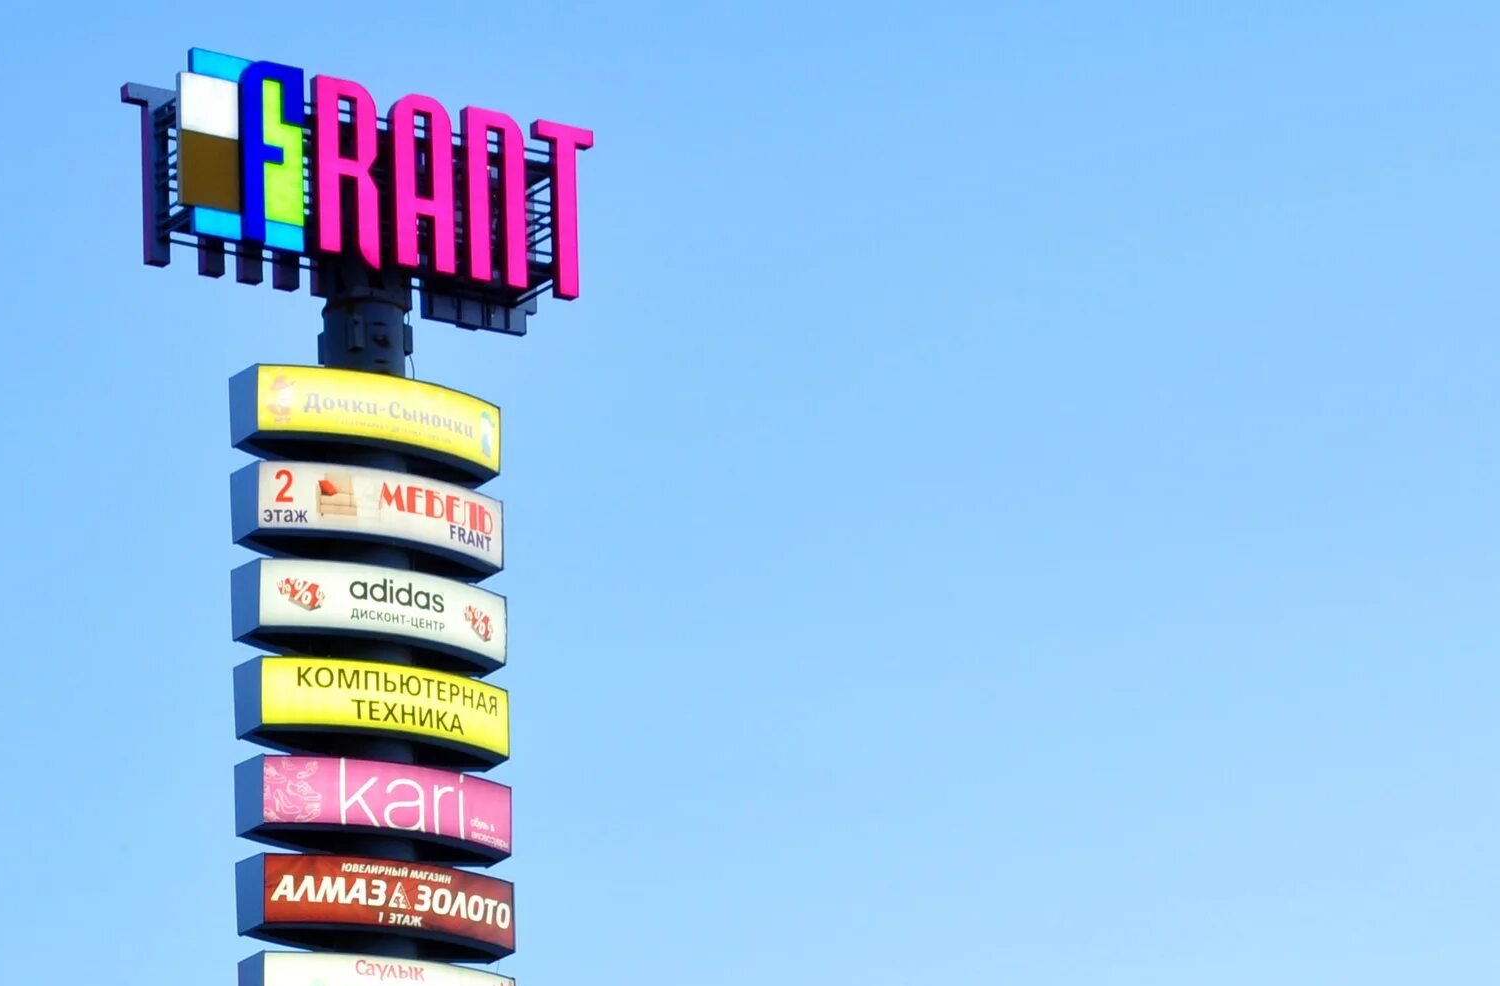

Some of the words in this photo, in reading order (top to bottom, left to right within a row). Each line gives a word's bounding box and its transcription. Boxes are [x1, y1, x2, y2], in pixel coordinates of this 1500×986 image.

[238, 60, 594, 300] FRANT
[303, 392, 474, 439] Дочки-Сыночки
[275, 469, 293, 502] 2
[263, 509, 308, 523] этаж
[379, 480, 493, 535] МЕБЕЛЬ
[450, 525, 492, 552] FRANT
[349, 578, 445, 613] adidas
[350, 607, 446, 633] ДИСКОНТ-ЦЕНТР
[297, 666, 498, 716] КОМПЬЮТЕРНАЯ
[351, 699, 464, 735] ТЕХНИКА
[339, 757, 465, 840] kari
[341, 862, 408, 878] ЮВЕЛИРНЫЙ
[409, 869, 452, 884] МАГАЗИН
[270, 874, 387, 907] АЛМАЗ
[414, 884, 511, 929] ЗОЛОТО
[388, 912, 423, 927] ЭТАЖ
[355, 959, 425, 982] Саулык
